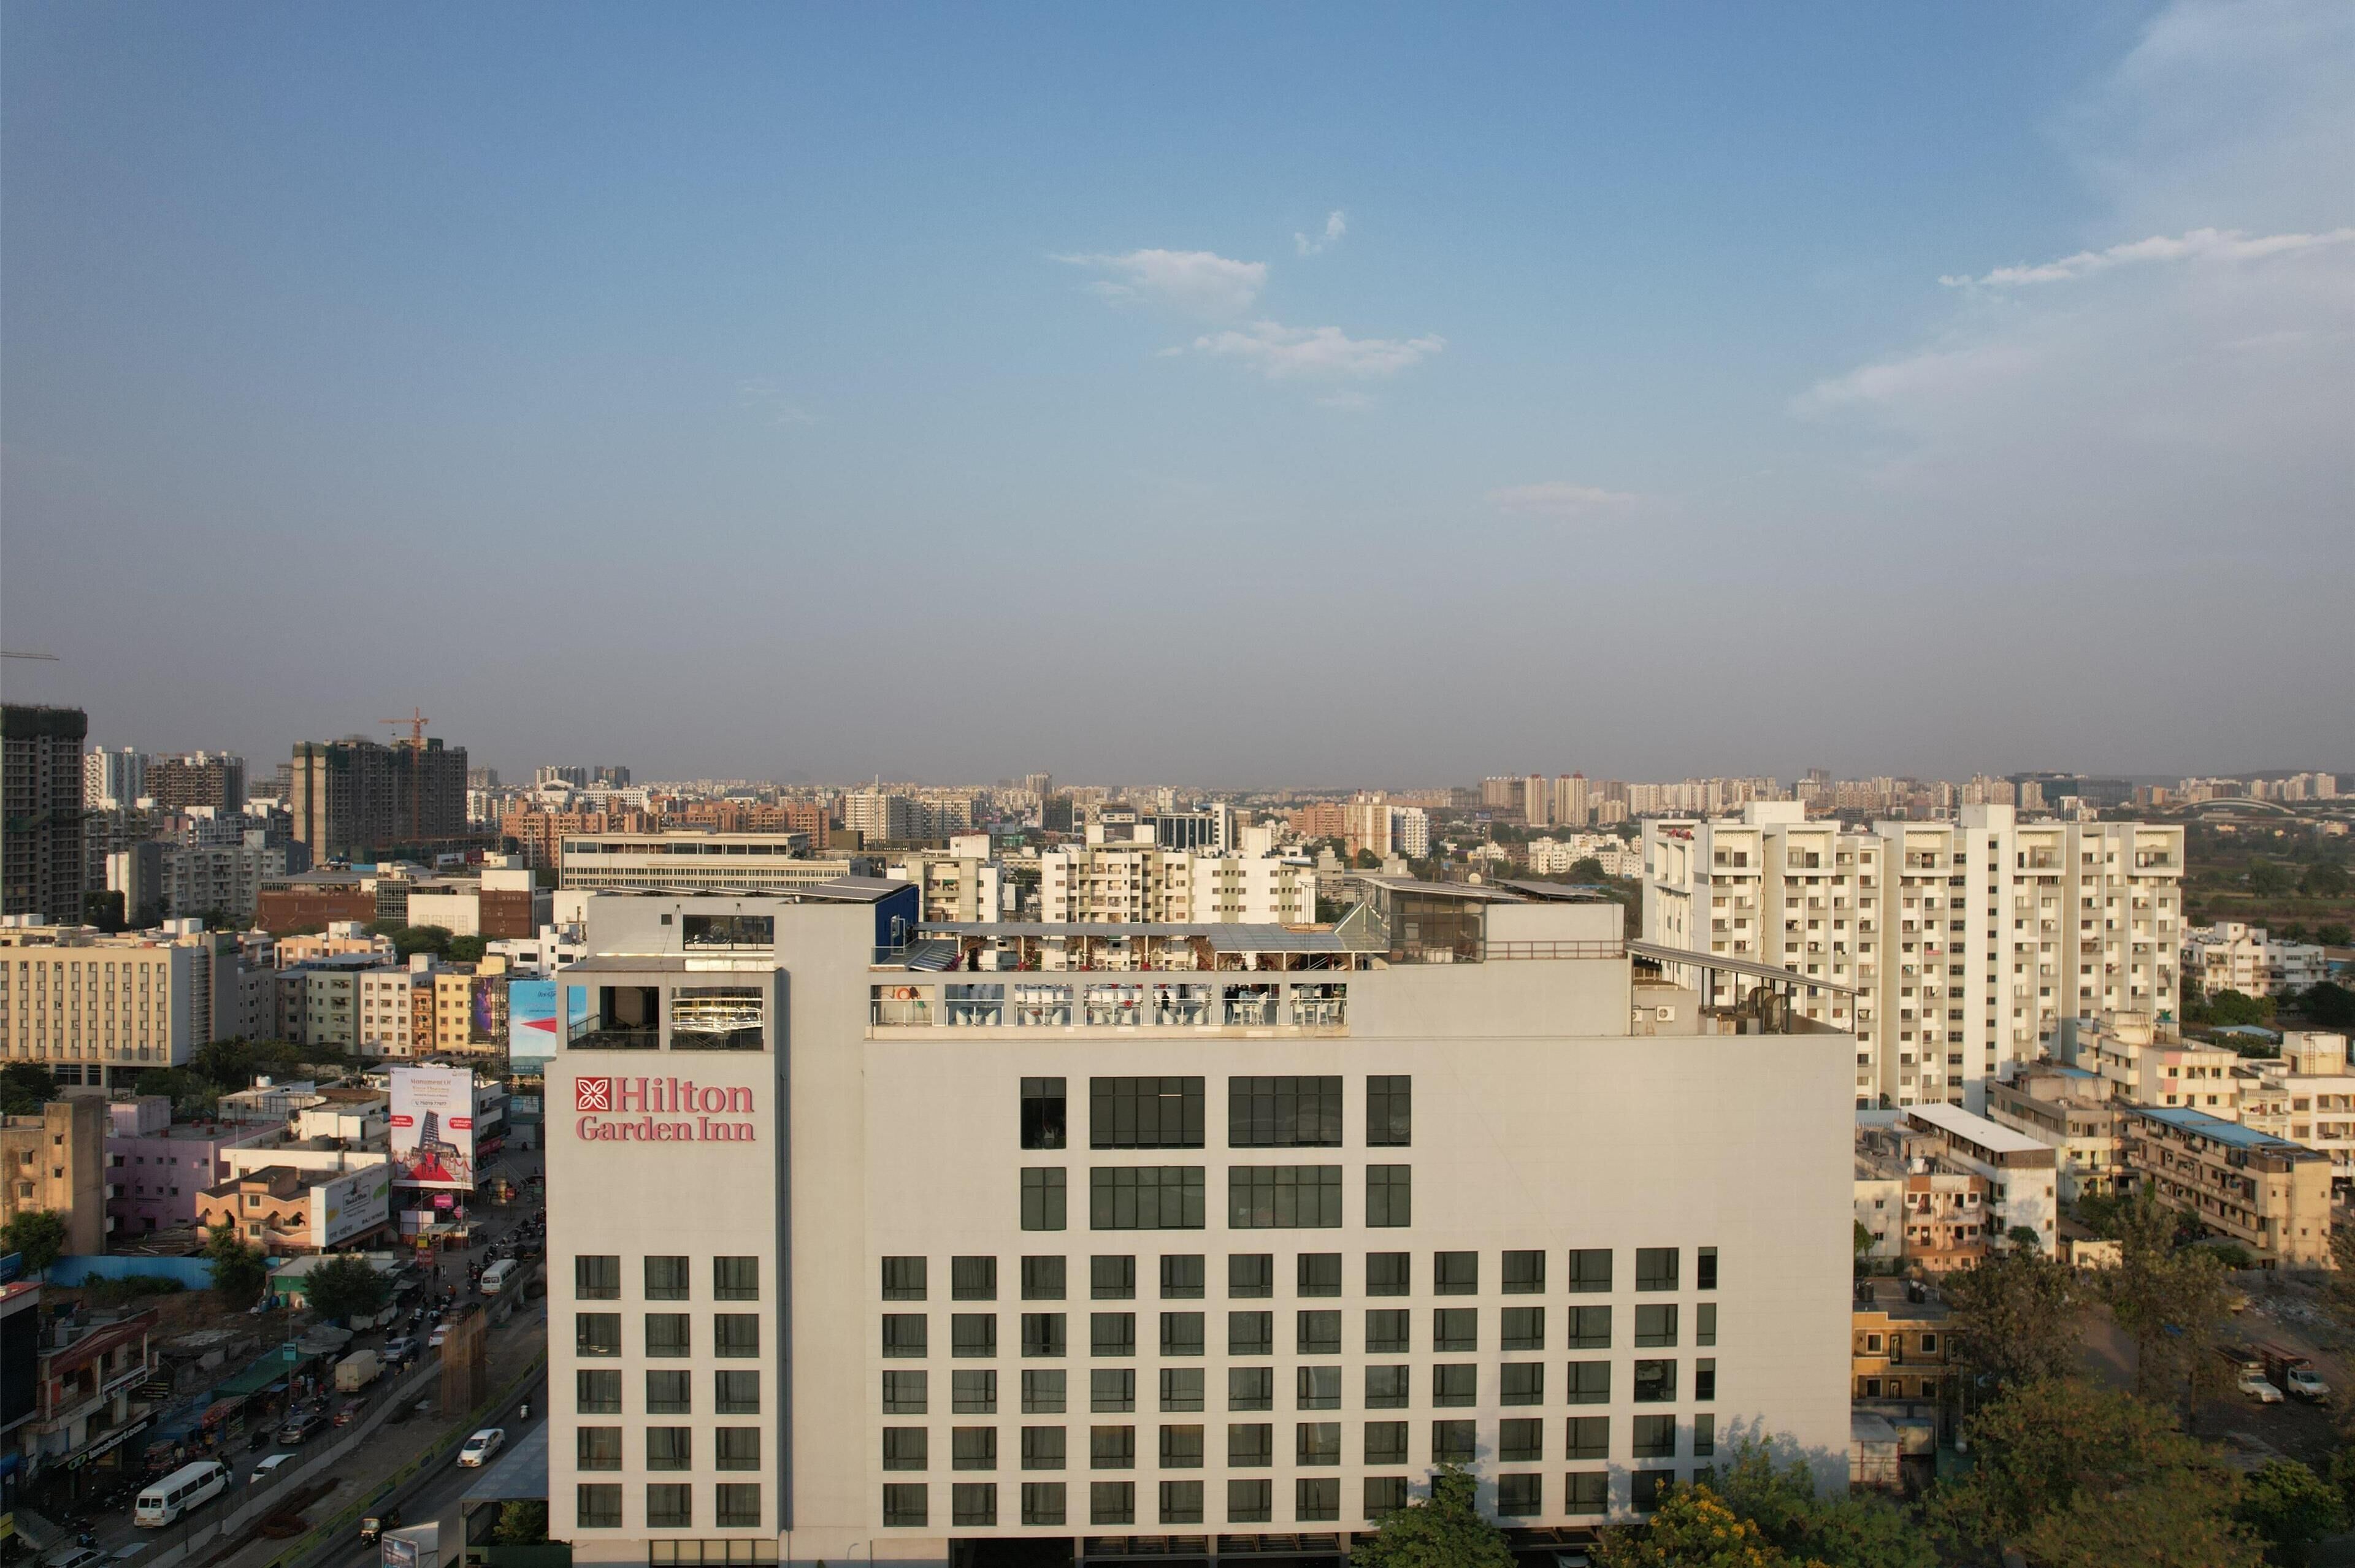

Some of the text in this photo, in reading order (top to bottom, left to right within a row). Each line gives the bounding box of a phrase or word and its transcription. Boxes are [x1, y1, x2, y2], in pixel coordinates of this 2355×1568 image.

[614, 1077, 754, 1113] Hilton
[576, 1116, 756, 1141] Garden Inn
[88, 1421, 148, 1459] lenskart.com
